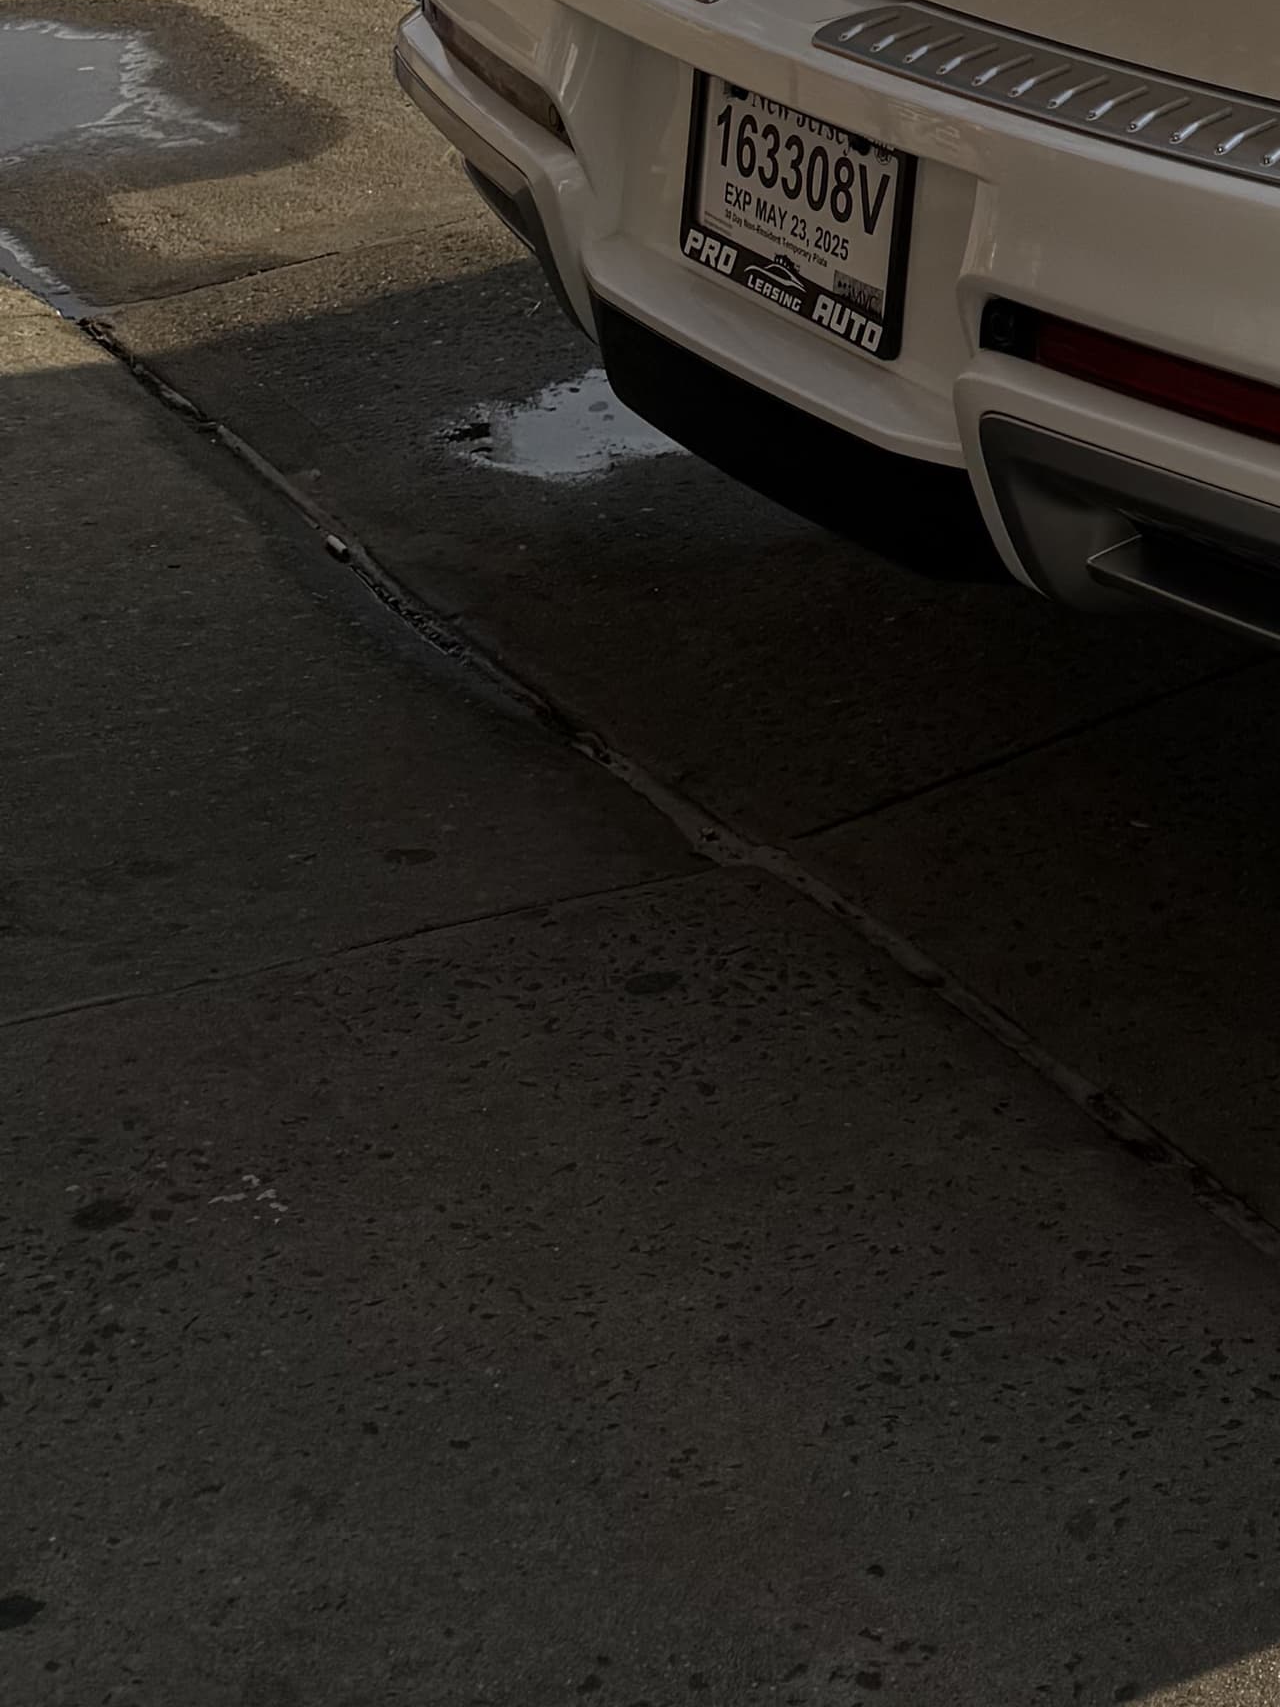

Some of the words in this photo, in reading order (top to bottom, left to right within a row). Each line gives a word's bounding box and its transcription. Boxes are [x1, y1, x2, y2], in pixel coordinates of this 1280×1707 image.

[717, 104, 891, 236] 163308V
[724, 181, 752, 212] EXP
[755, 197, 788, 230] MAY
[790, 215, 810, 247] 23,
[814, 226, 850, 261] 2025
[683, 228, 738, 276] PRO
[746, 274, 803, 313] LEASING
[811, 293, 884, 353] AUTO
